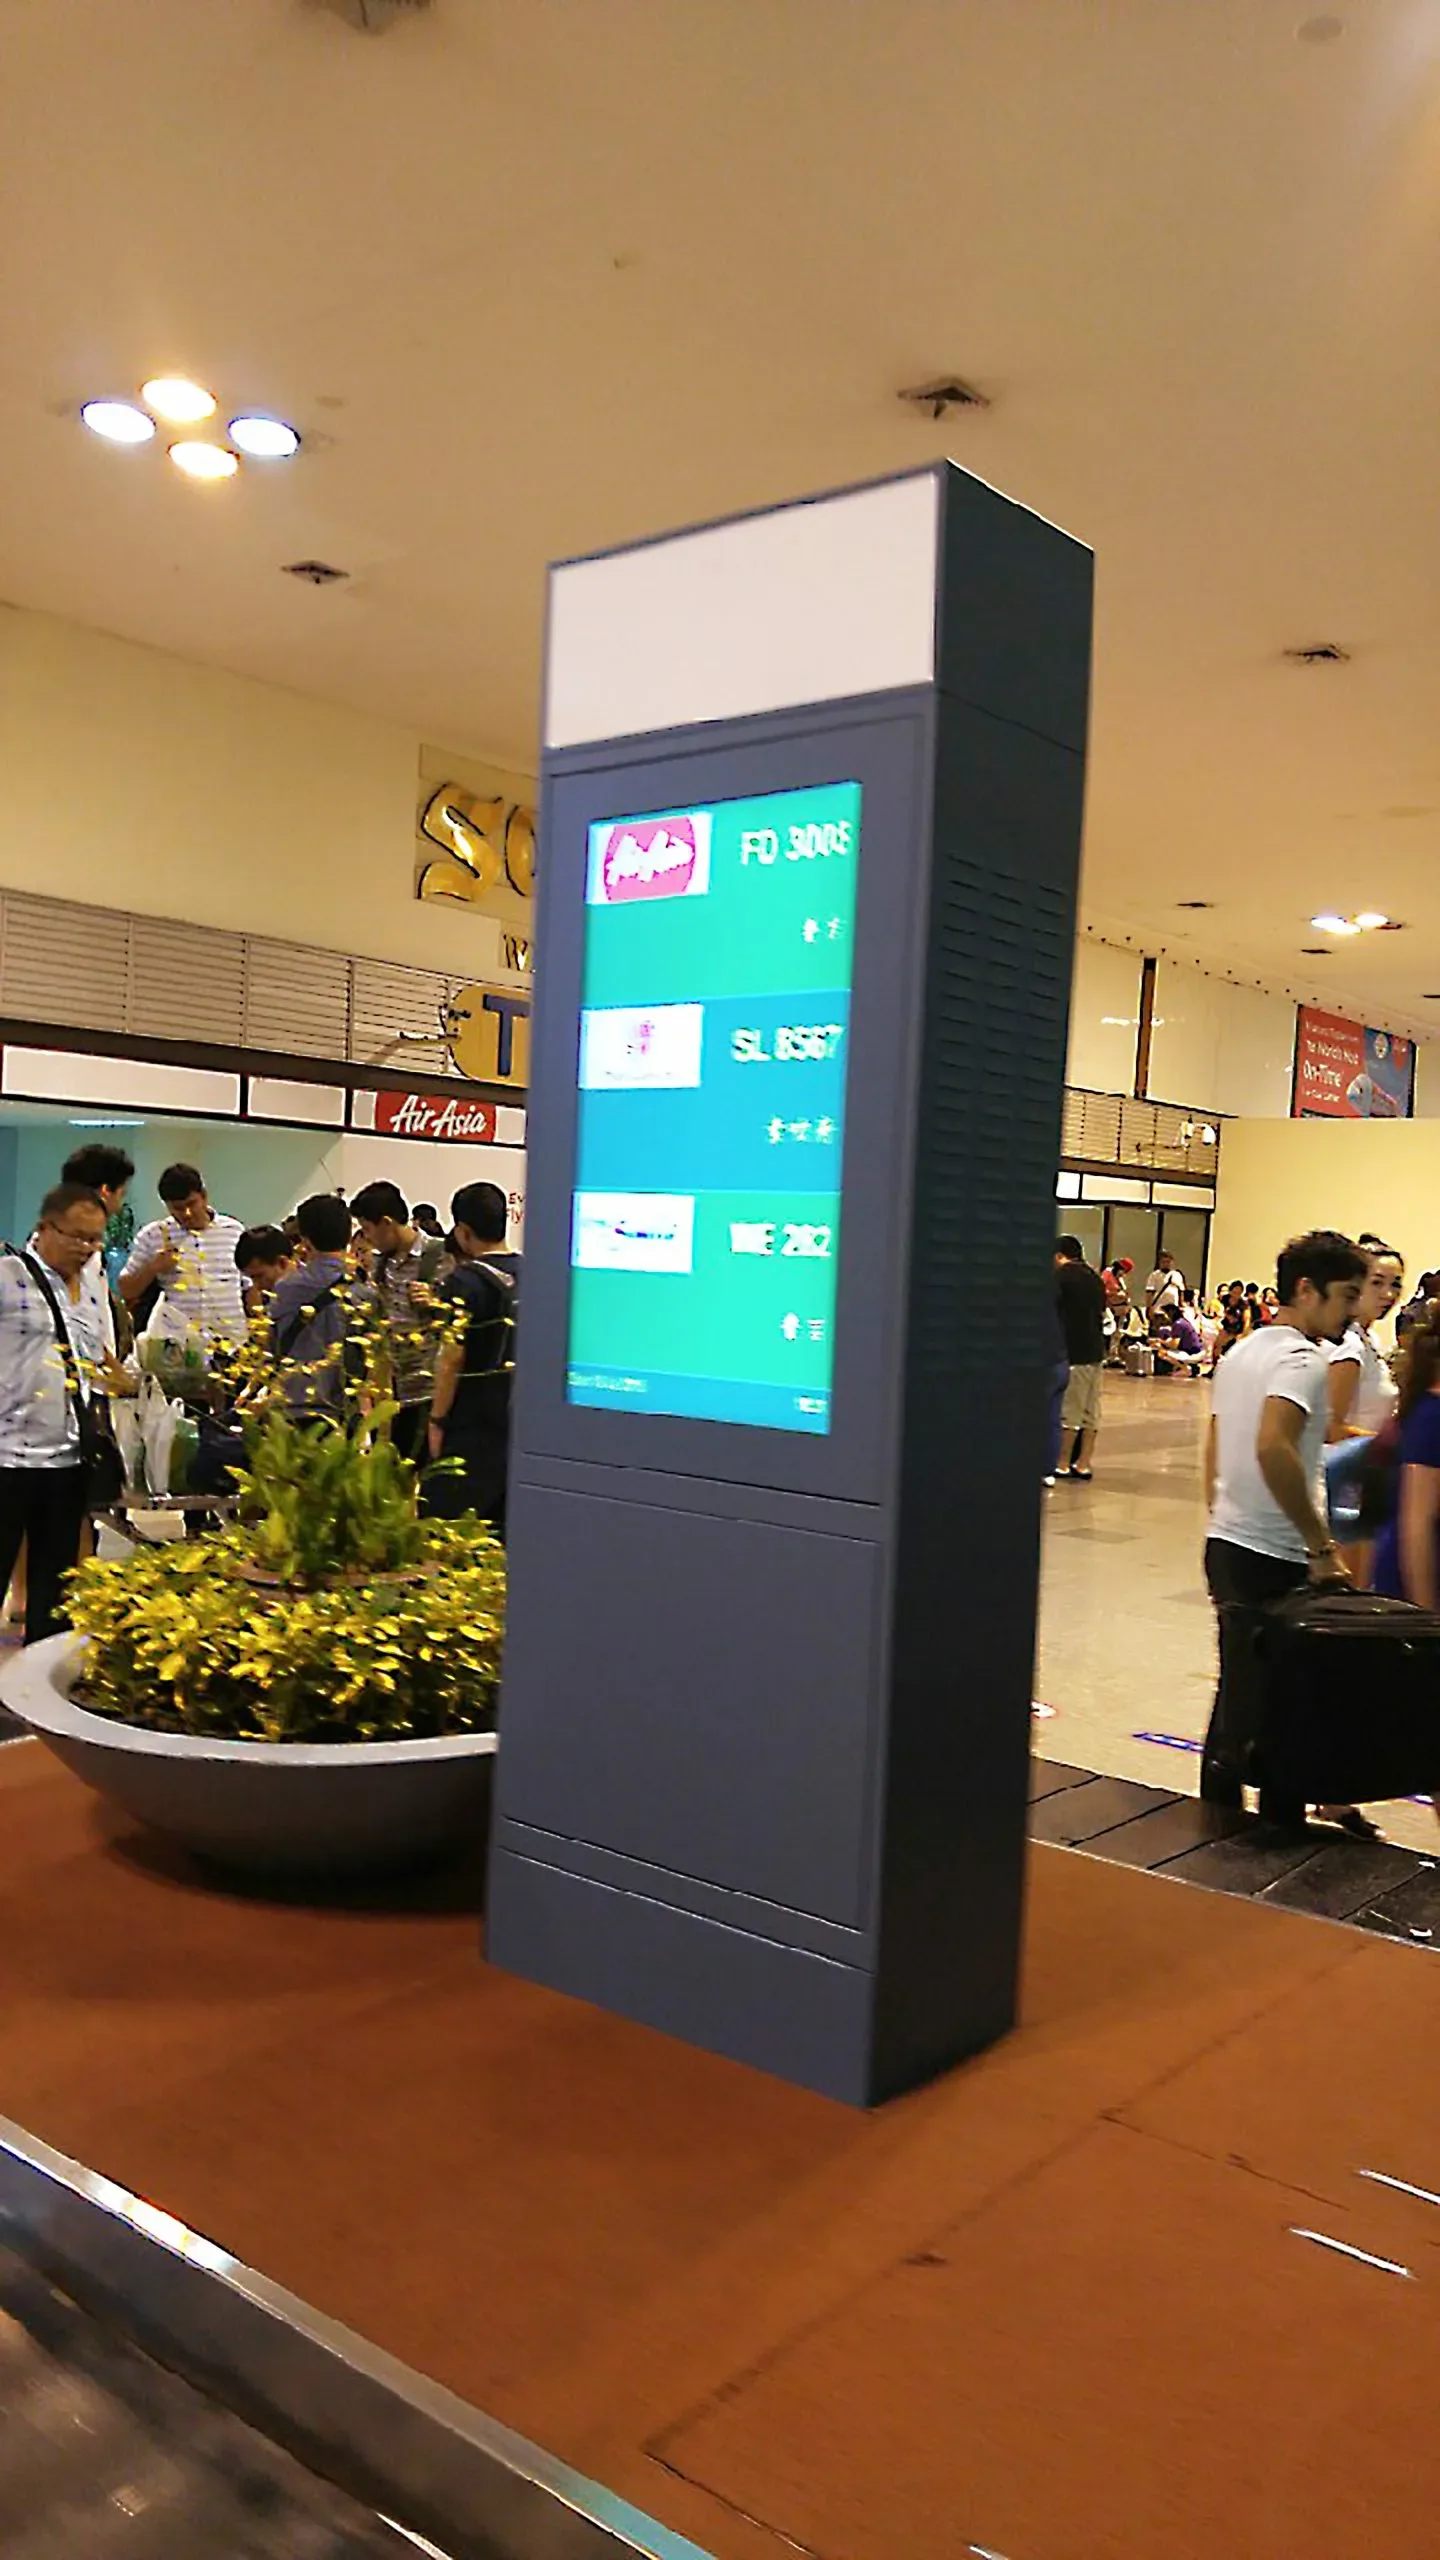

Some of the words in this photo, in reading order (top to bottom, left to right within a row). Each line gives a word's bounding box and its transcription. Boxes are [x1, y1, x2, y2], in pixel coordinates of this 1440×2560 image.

[740, 828, 779, 865] FD
[731, 1028, 771, 1062] SL
[390, 1094, 487, 1137] AirAsia
